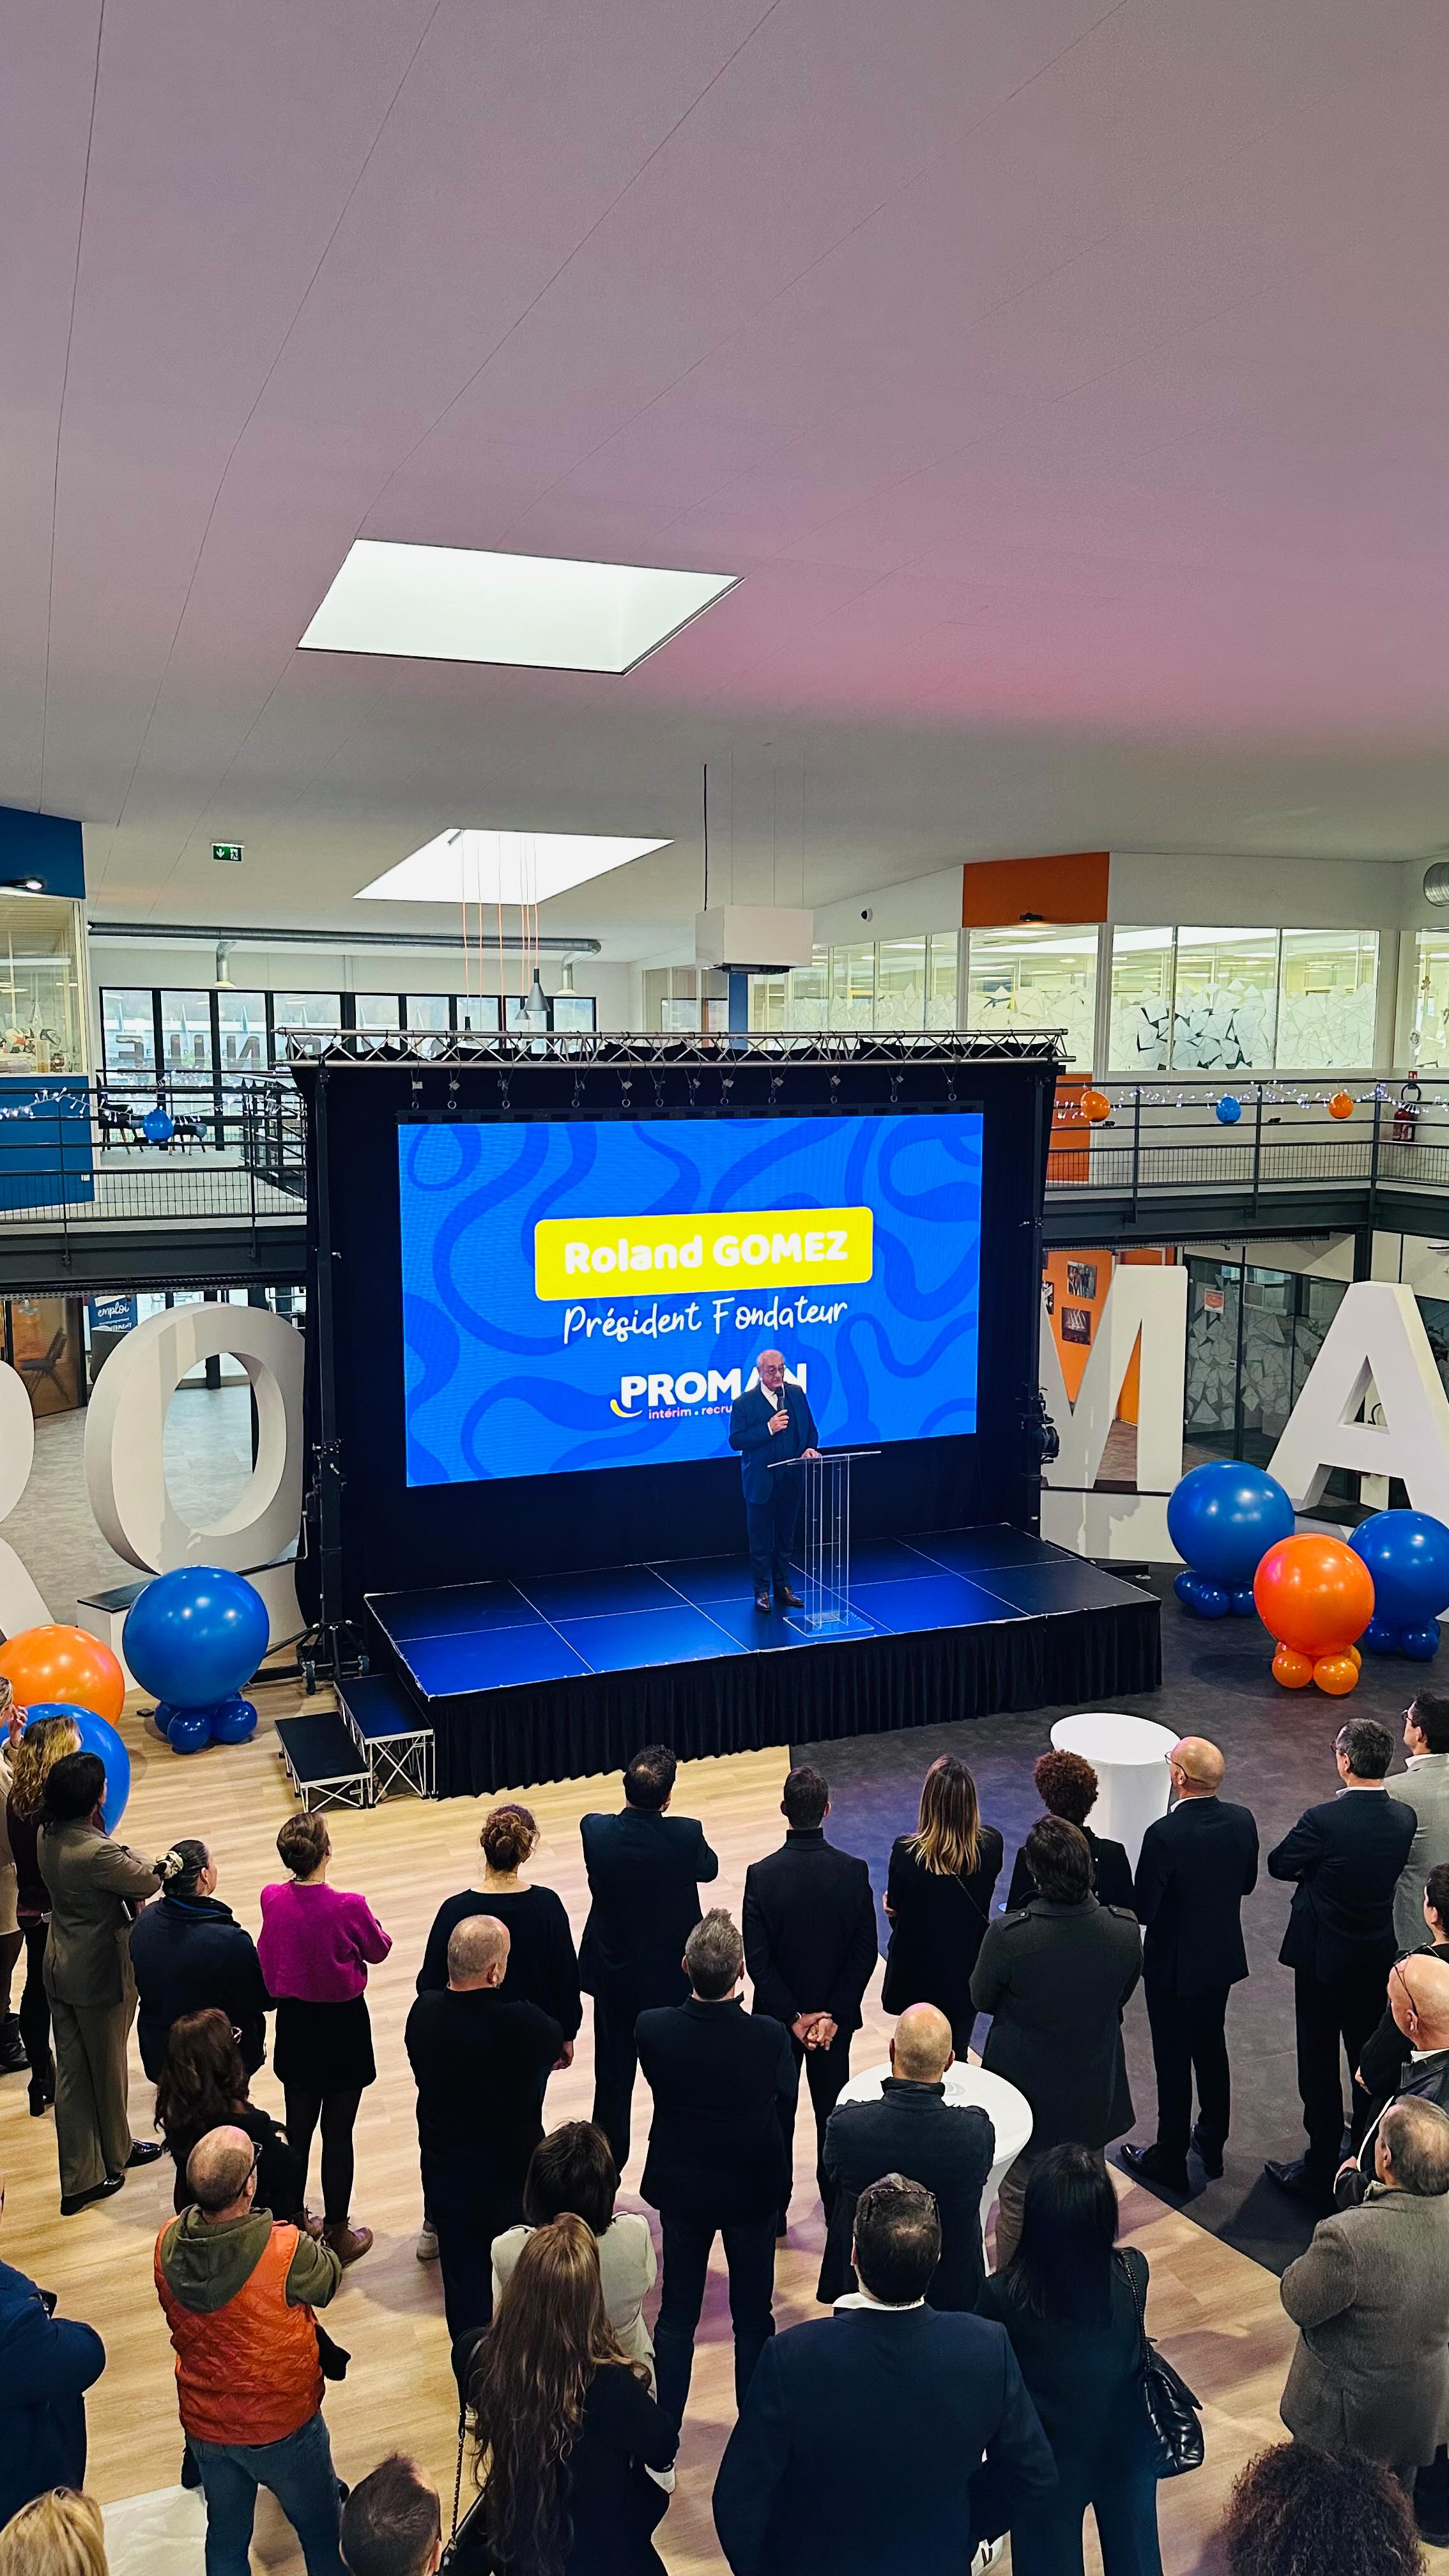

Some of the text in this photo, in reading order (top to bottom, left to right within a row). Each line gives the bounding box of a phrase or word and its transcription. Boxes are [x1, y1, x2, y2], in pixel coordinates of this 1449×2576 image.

[565, 1230, 848, 1274] Roland GOMEZ
[98, 1301, 129, 1319] emploi
[564, 1295, 848, 1345] Président Fondateur
[648, 1405, 733, 1420] intérim recru
